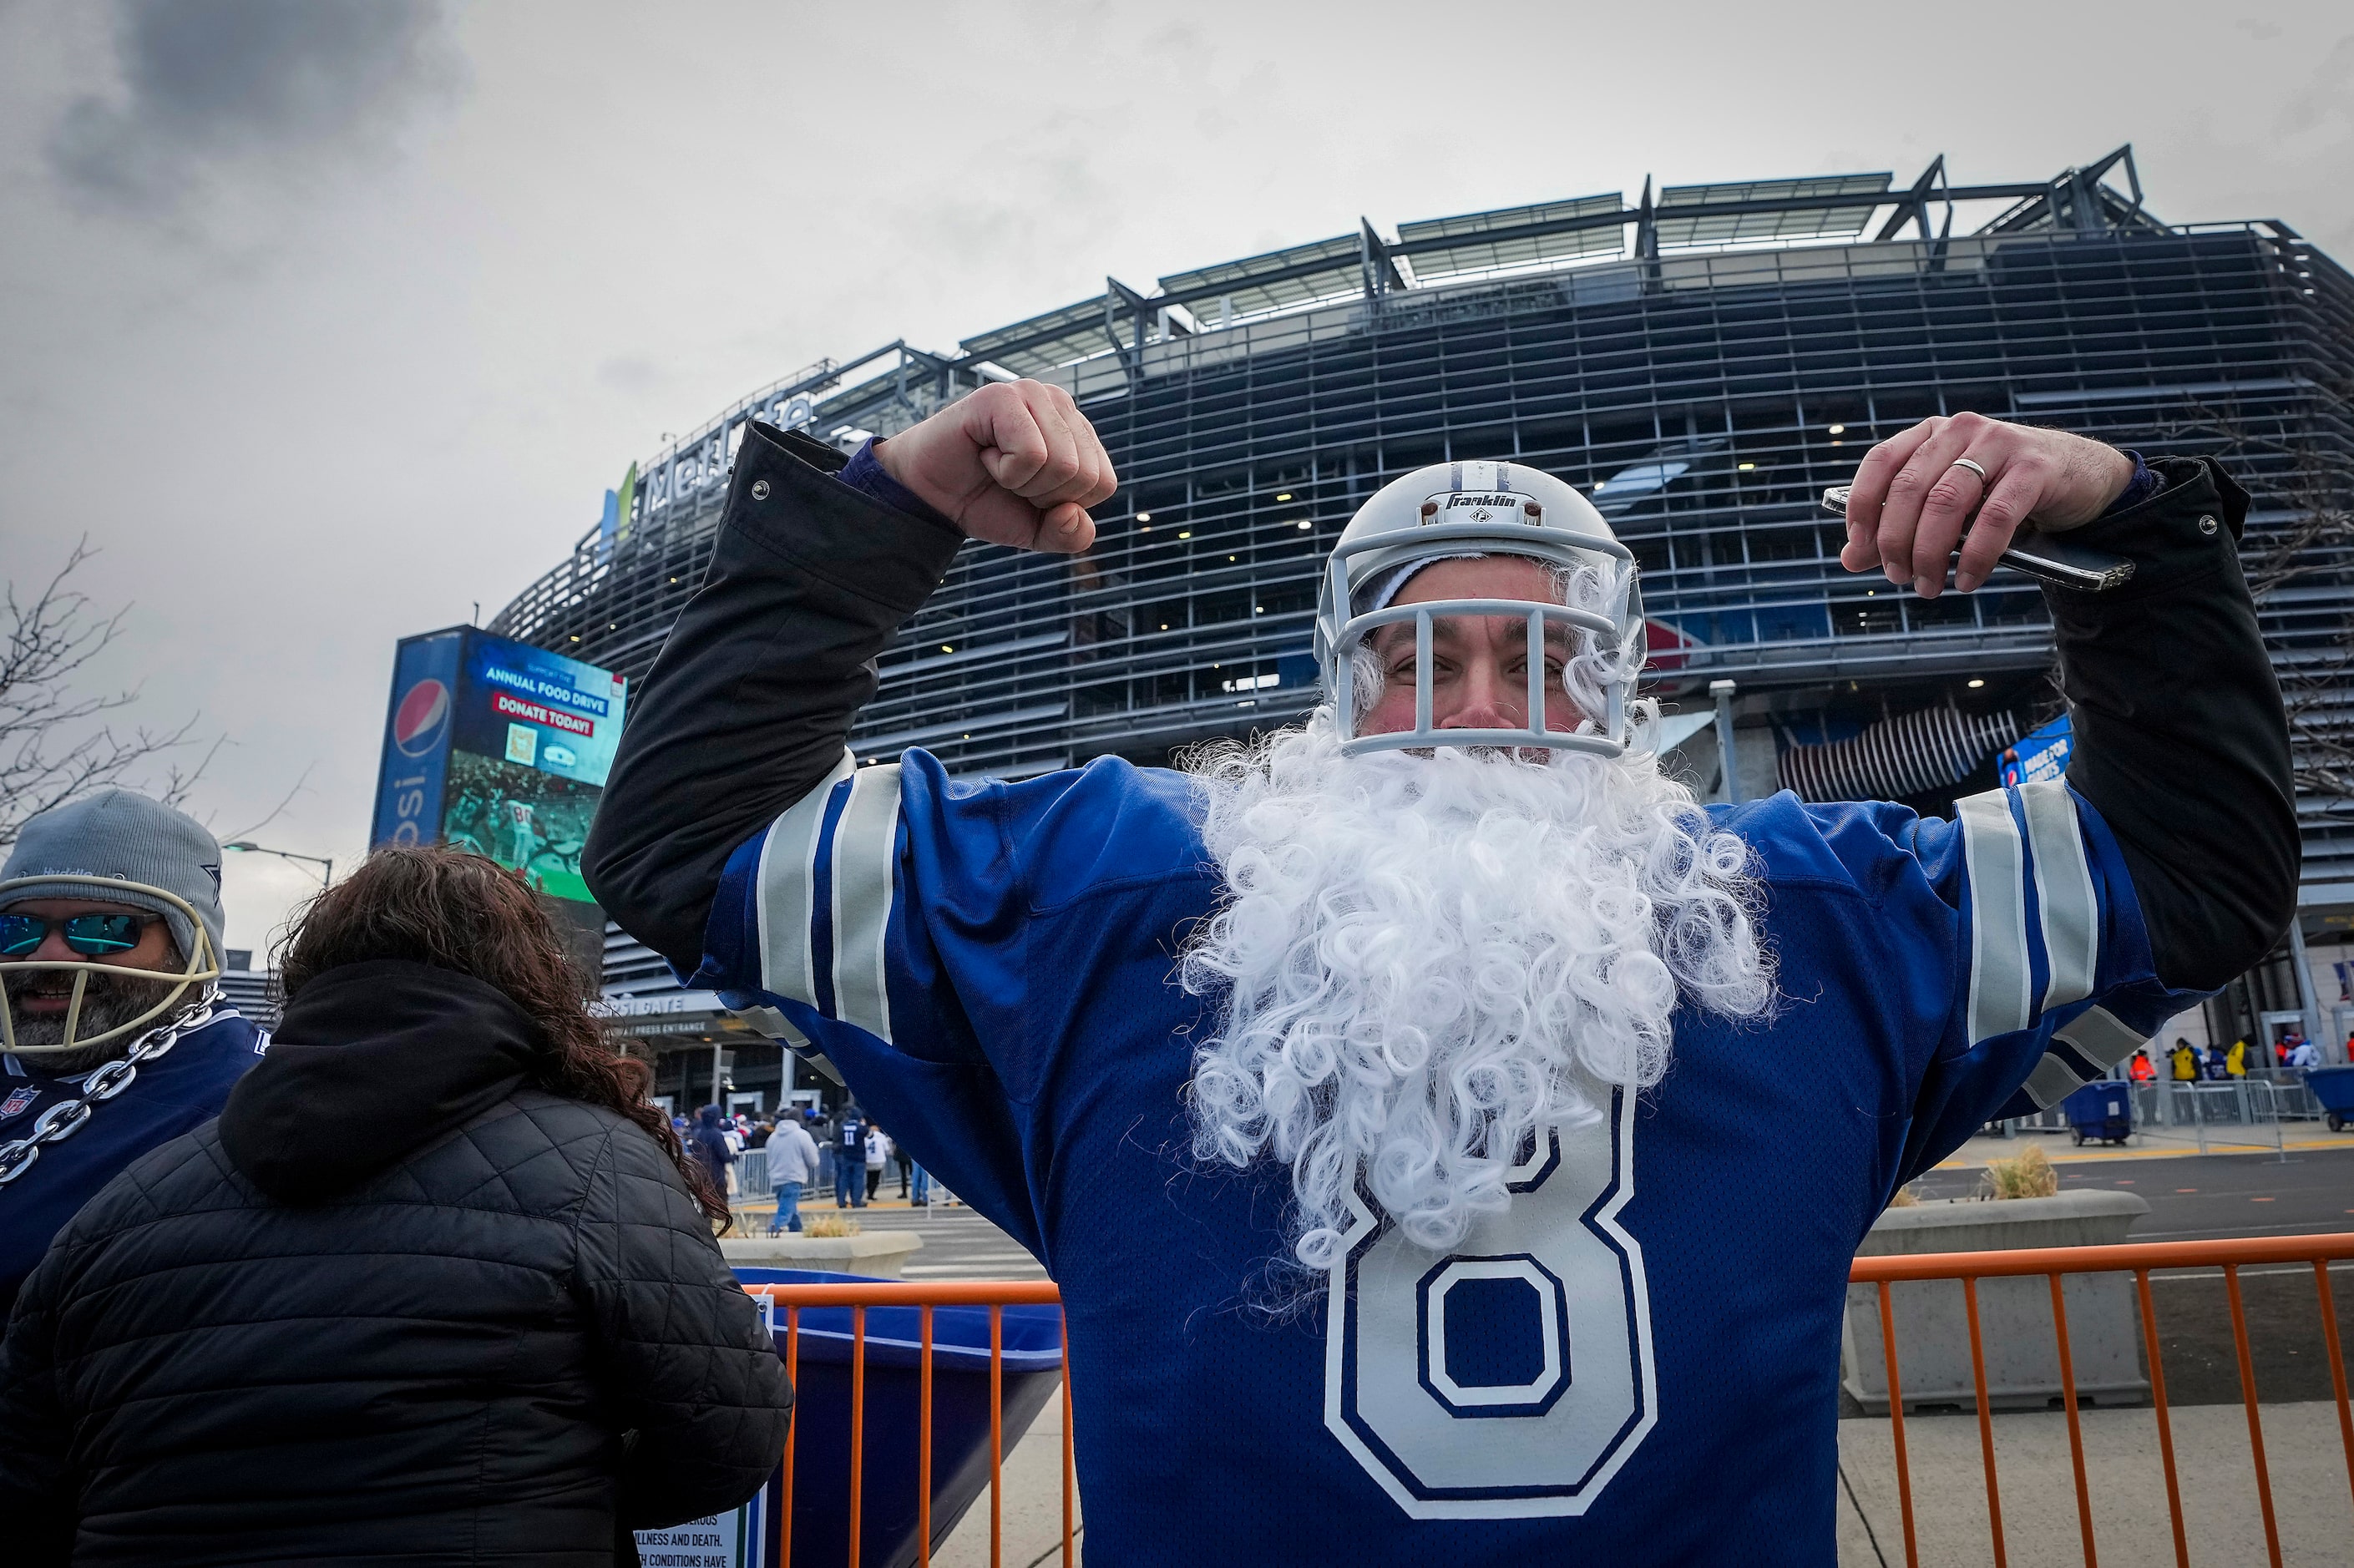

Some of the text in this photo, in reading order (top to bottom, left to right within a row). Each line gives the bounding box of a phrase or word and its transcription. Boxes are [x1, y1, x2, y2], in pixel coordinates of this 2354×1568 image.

[642, 390, 816, 516] MetLfe
[485, 667, 605, 713] ANNUAL FOOD DRIVE
[499, 696, 590, 734] DONATE TODAY!
[642, 997, 683, 1014] GATE
[635, 1025, 661, 1035] PRESS
[662, 1021, 706, 1034] ENTRANCE
[844, 1131, 855, 1146] 11
[868, 1141, 876, 1154] 4
[671, 1535, 690, 1546] AND
[692, 1535, 723, 1547] DEATH.
[650, 1554, 701, 1567] CONDITIONS
[704, 1555, 727, 1568] HAVE
